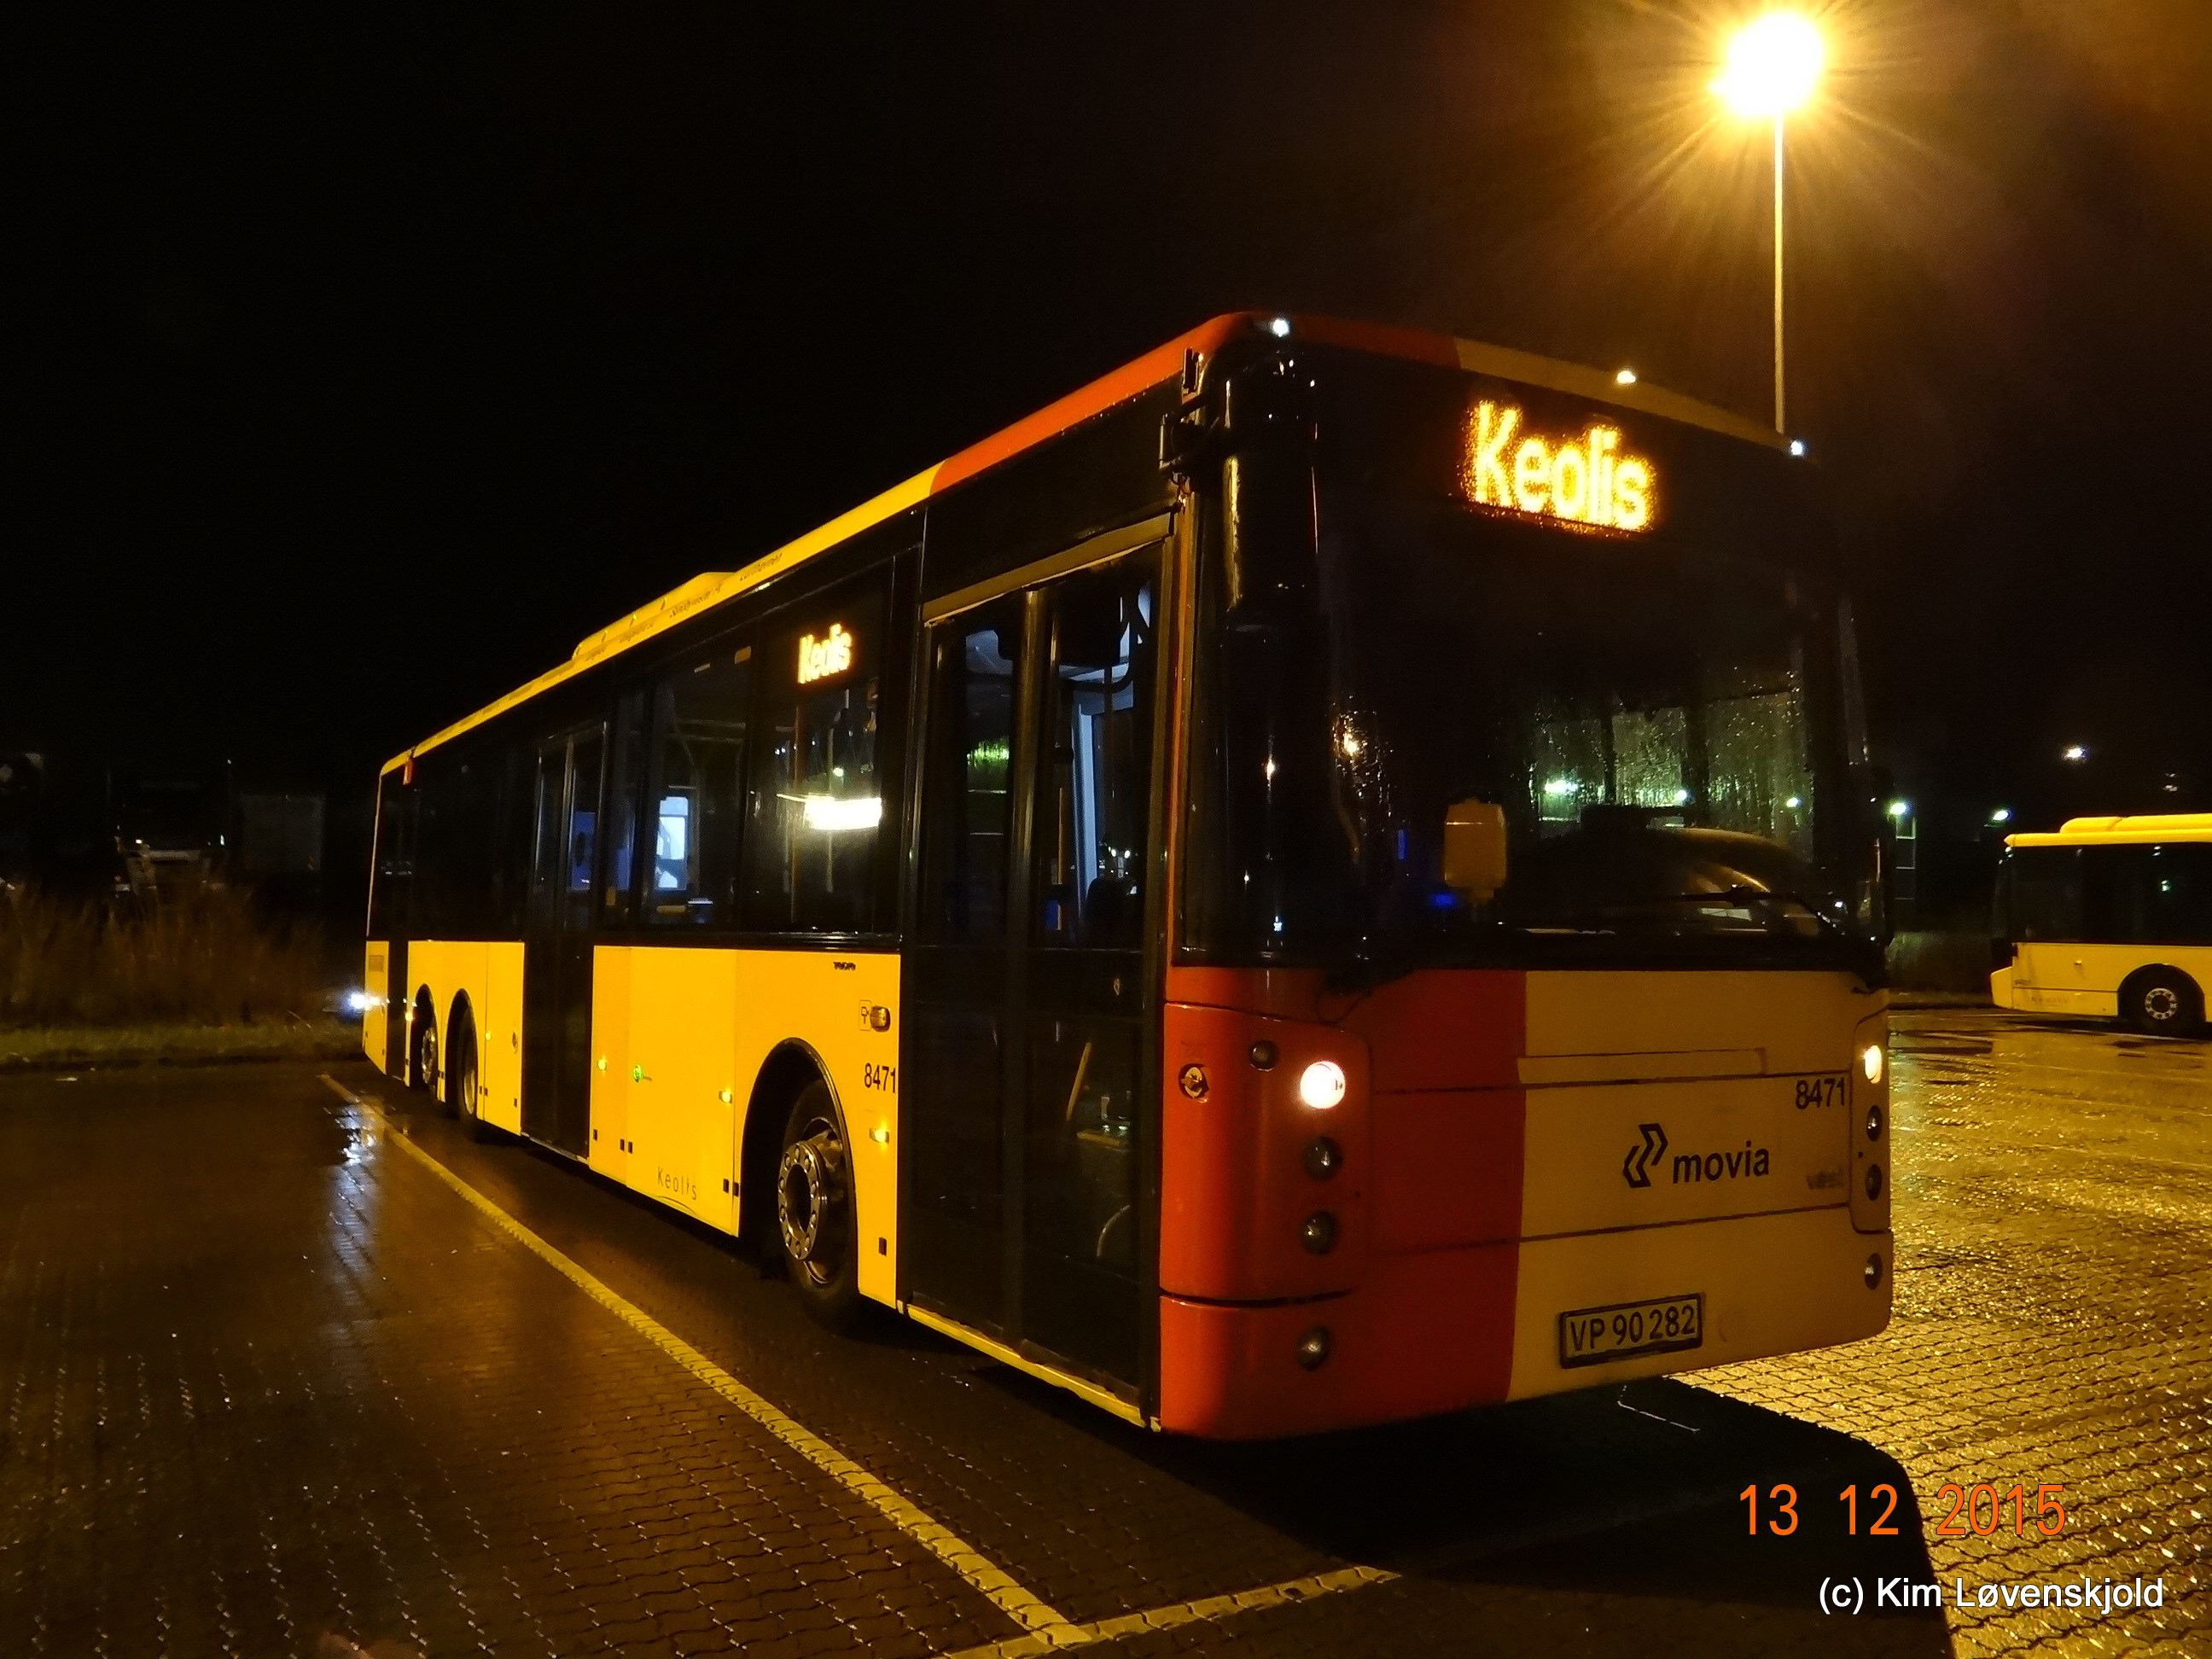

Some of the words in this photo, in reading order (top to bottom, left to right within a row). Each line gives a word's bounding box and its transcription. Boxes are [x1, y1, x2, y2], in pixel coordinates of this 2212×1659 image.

[1470, 399, 1654, 531] Keolis
[864, 1062, 896, 1094] 8471
[1795, 1077, 1846, 1109] 8471
[1673, 1140, 1770, 1185] movia
[656, 1166, 697, 1201] Keolis
[1570, 1318, 1605, 1352] VP
[1613, 1311, 1644, 1345] 90
[1649, 1304, 1697, 1338] 282
